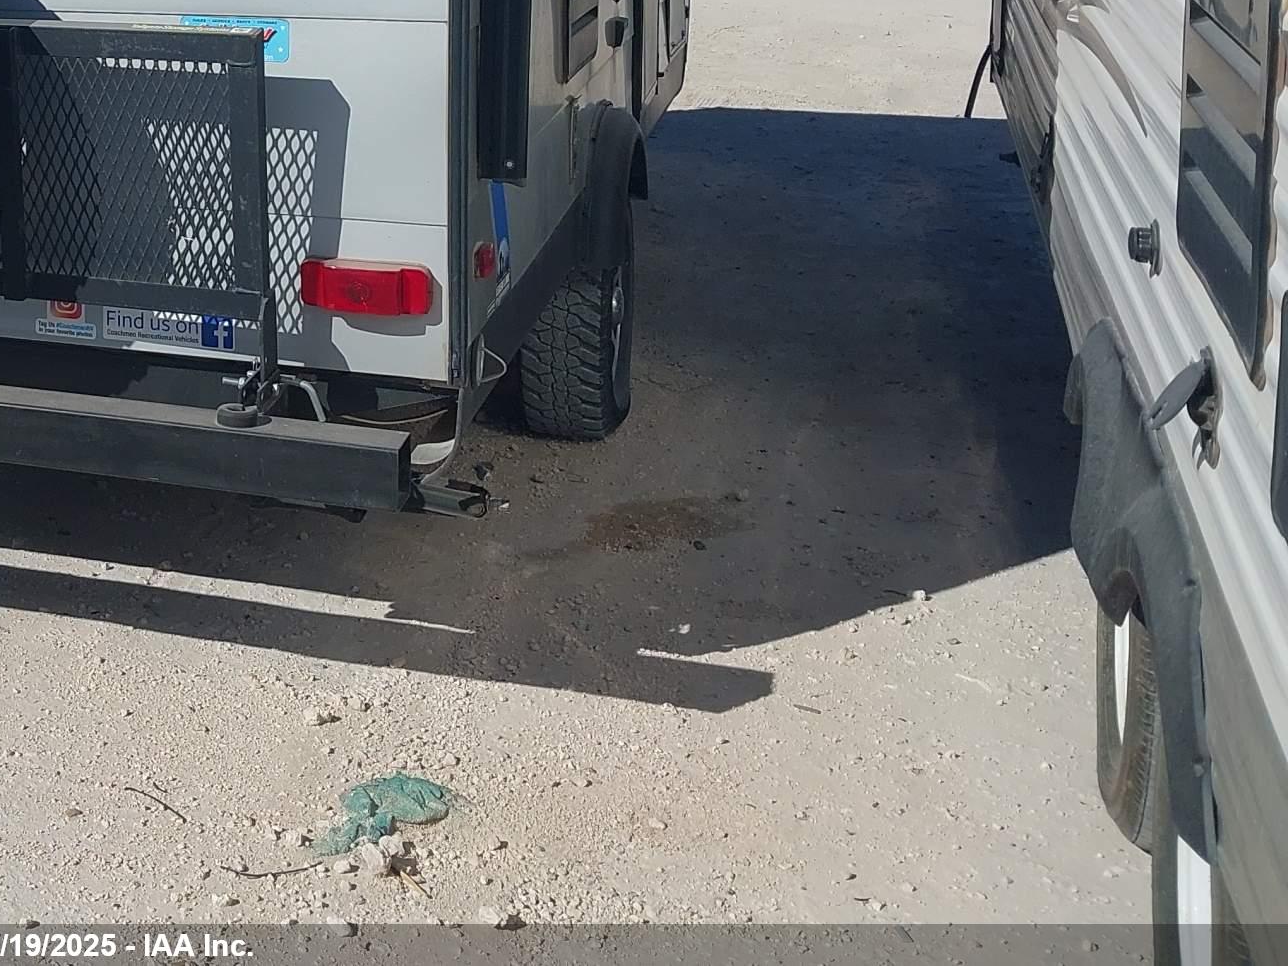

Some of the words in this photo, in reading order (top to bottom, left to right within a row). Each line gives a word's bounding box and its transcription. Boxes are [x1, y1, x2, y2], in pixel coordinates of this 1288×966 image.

[106, 310, 144, 330] Find
[151, 315, 170, 332] us
[175, 319, 199, 335] on
